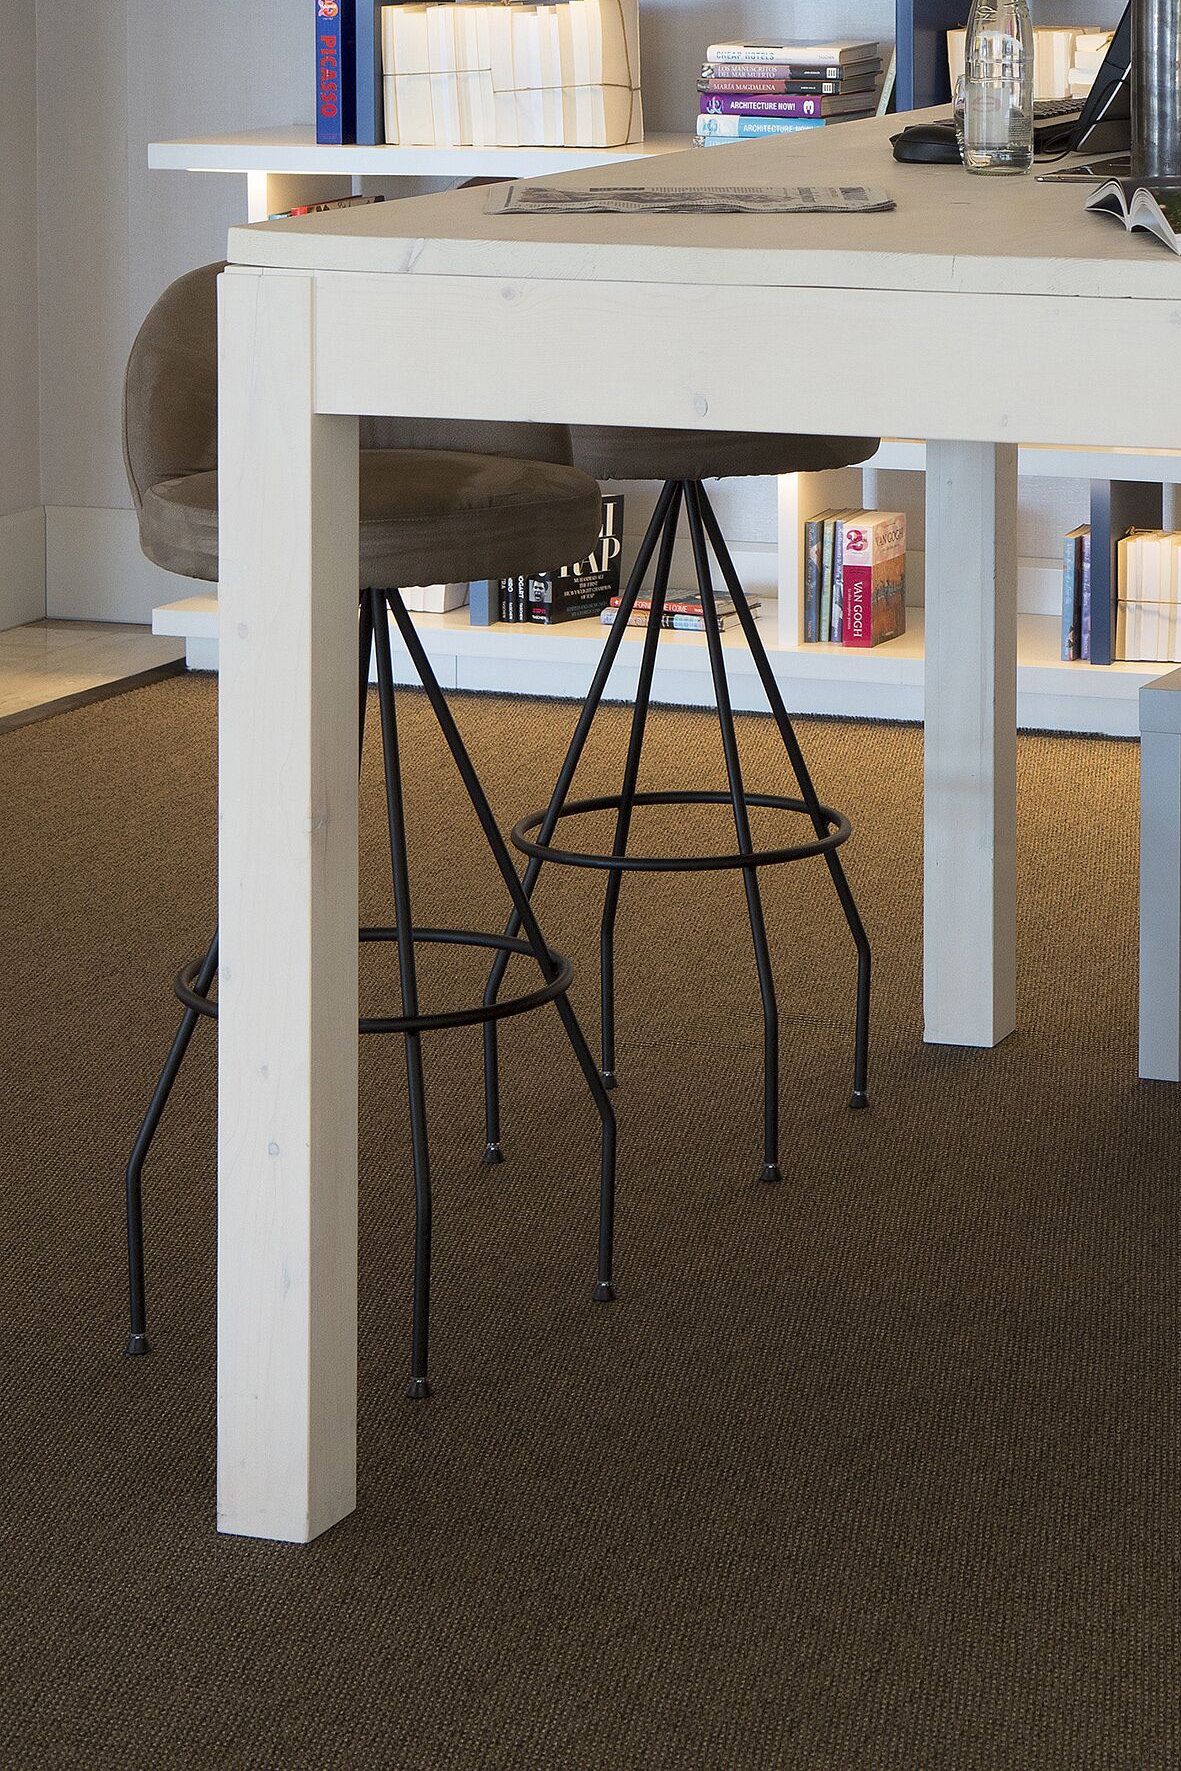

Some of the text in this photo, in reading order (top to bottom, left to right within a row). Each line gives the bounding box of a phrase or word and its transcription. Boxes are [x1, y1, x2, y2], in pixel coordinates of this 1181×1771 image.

[716, 51, 775, 61] CHEAP HOTELS
[319, 35, 338, 118] PICASSO
[713, 82, 776, 91] MARÍA MAGDALENA
[730, 101, 796, 111] ARCHITECTURE NOW!
[743, 124, 793, 133] ARCHITECTURE
[875, 526, 904, 547] VAN GOGH
[853, 581, 863, 638] VAN GOGH
